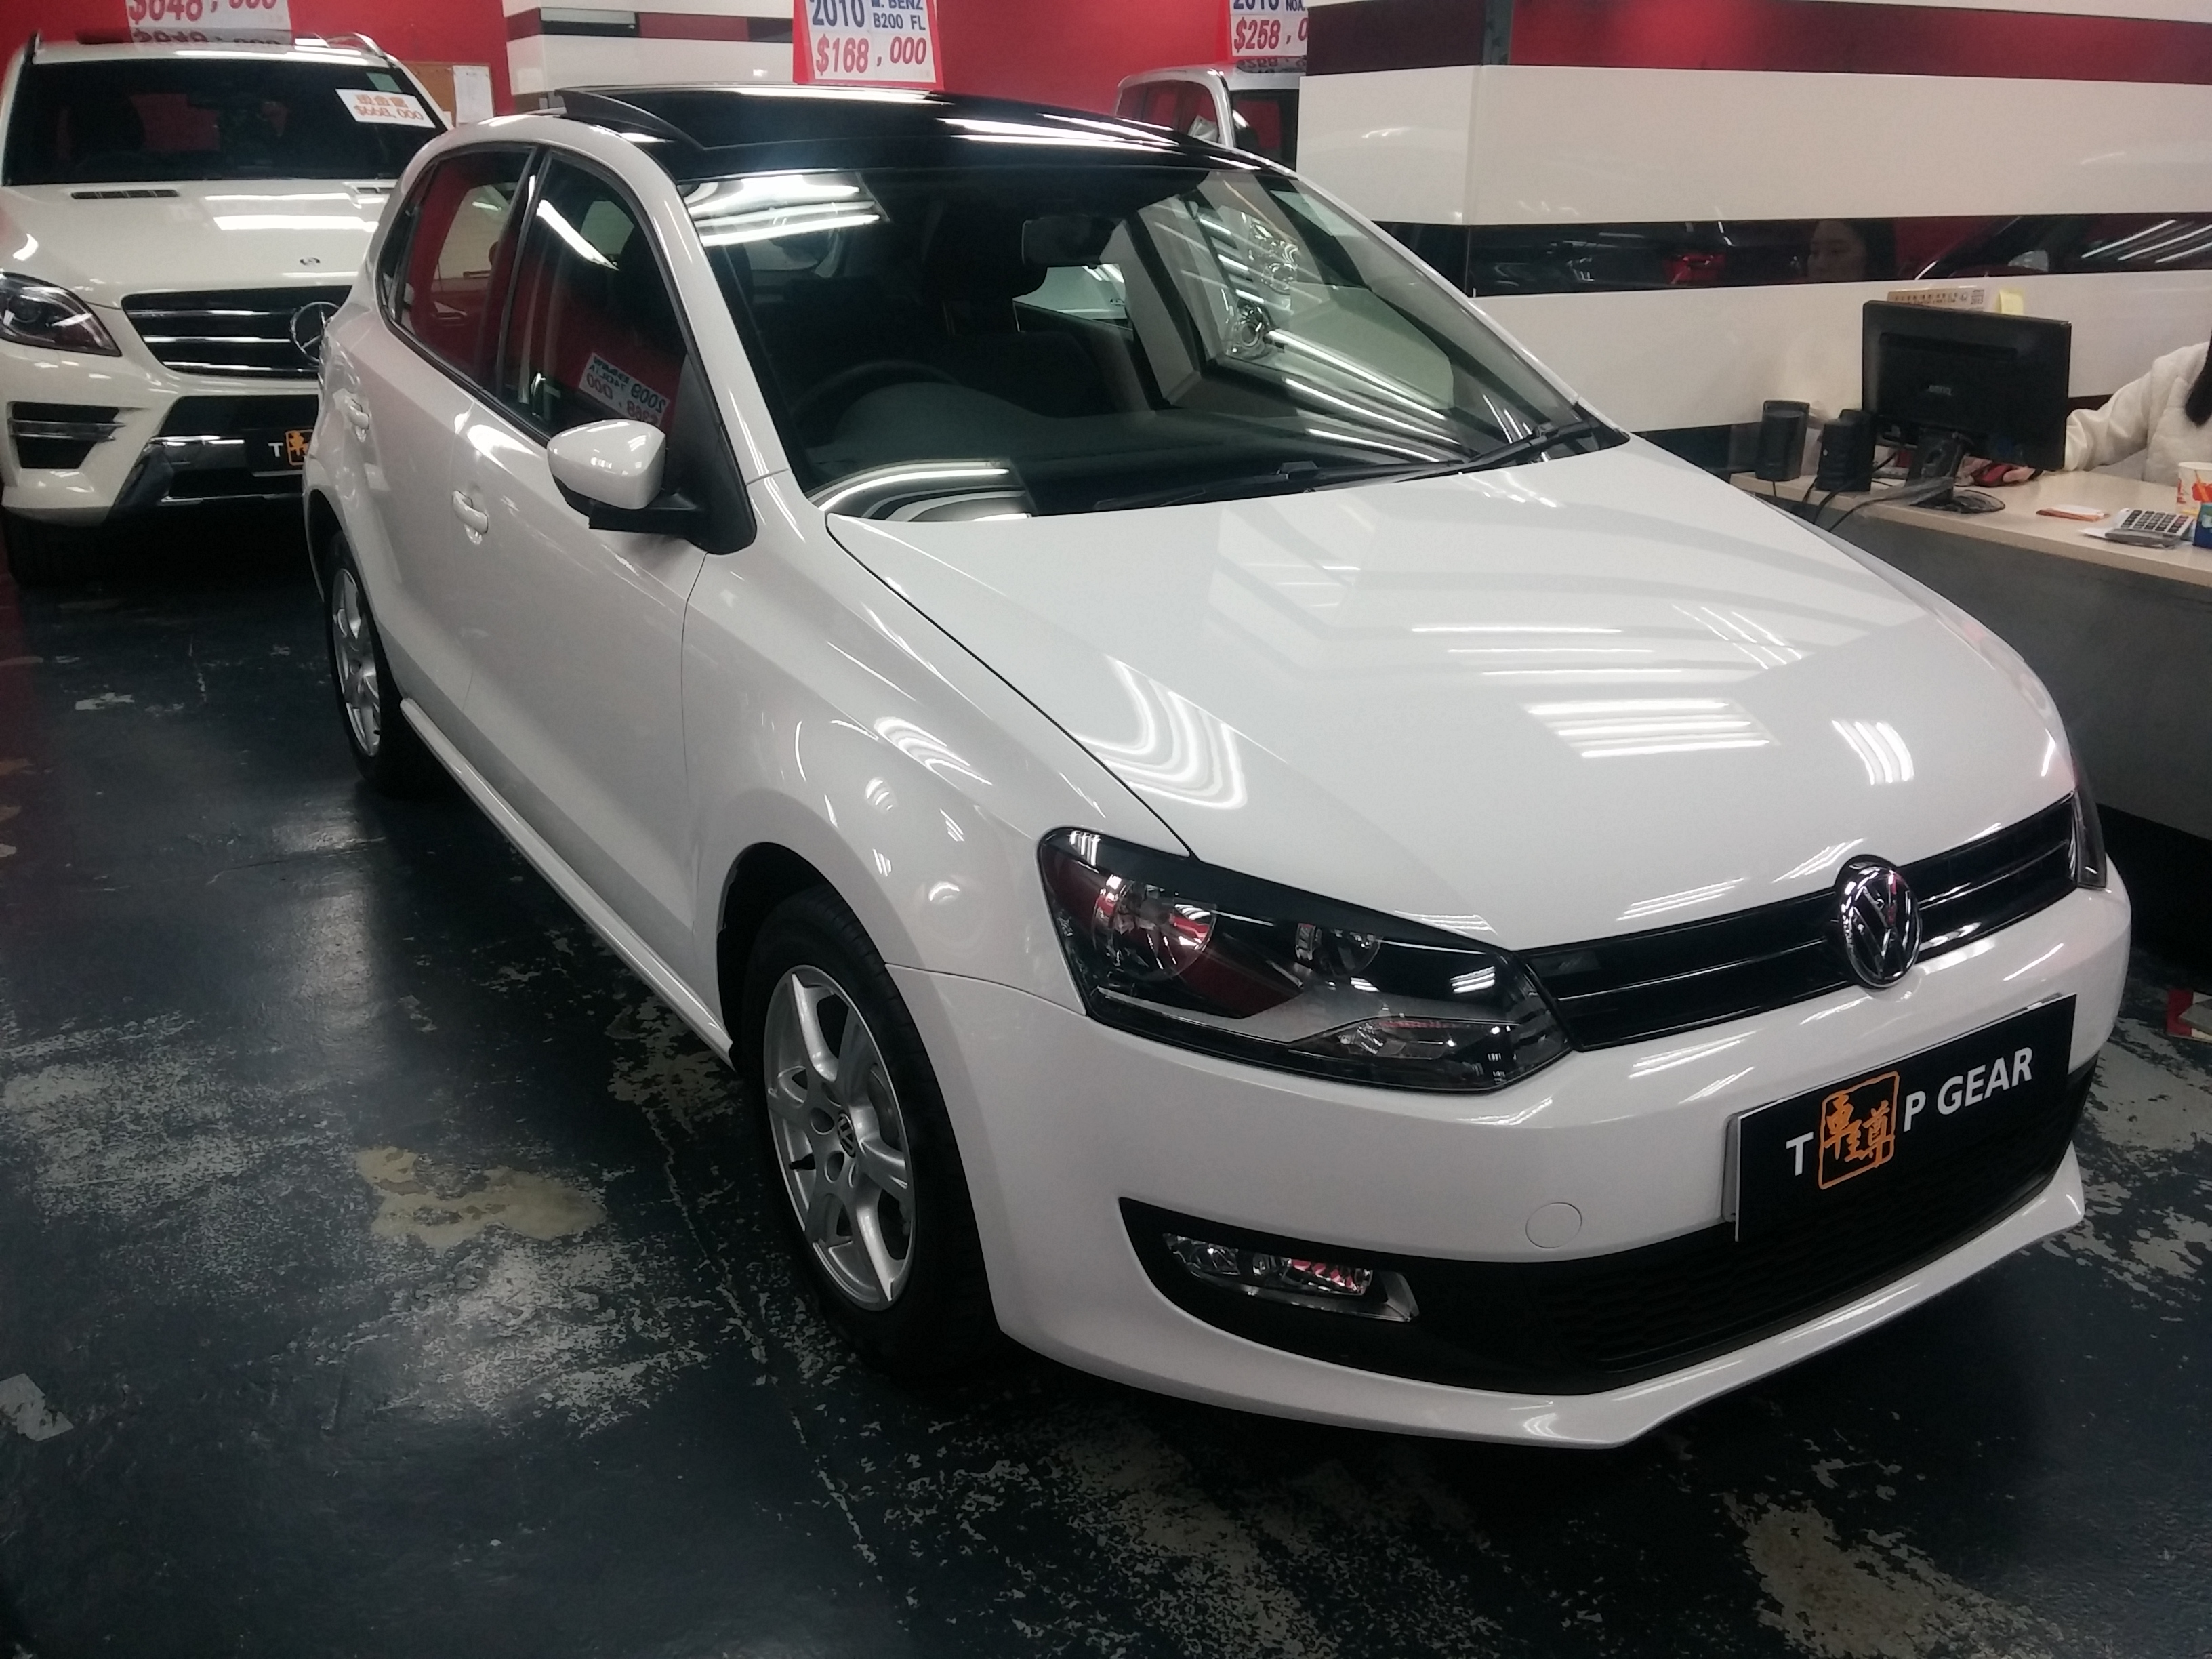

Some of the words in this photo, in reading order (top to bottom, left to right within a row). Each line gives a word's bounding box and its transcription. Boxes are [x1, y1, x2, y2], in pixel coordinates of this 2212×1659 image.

[810, 0, 865, 28] 2010
[873, 12, 903, 29] B200
[910, 14, 926, 30] FL
[267, 442, 284, 457] T
[1786, 1131, 1815, 1177] T
[1937, 1046, 2033, 1115] GEAR
